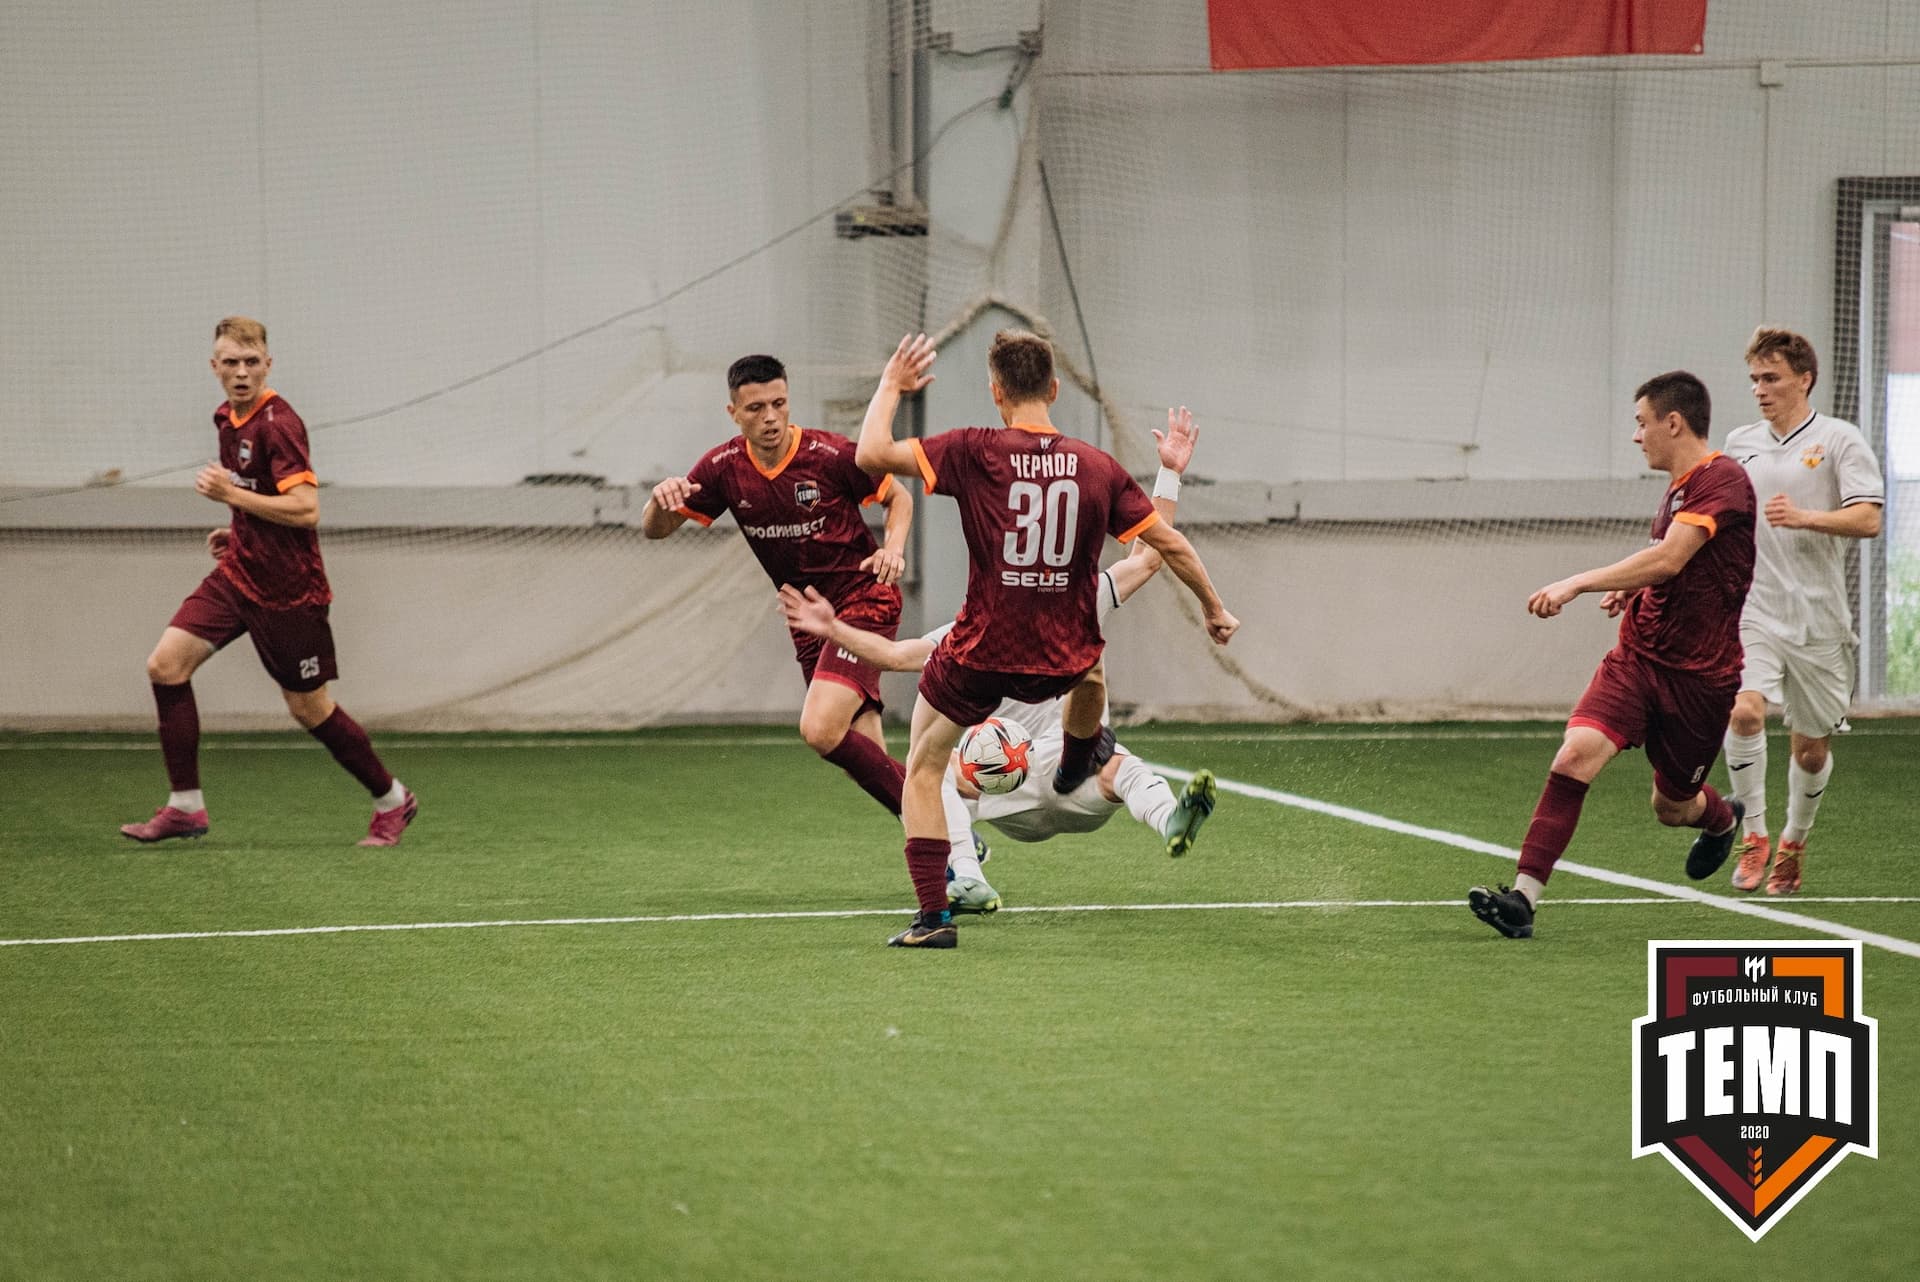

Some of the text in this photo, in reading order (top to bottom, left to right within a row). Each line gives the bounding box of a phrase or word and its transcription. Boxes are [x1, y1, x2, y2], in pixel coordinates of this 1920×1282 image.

[1010, 453, 1078, 479] ЧЕРНОВ
[1003, 479, 1080, 567] 30
[1001, 570, 1070, 588] SEUS
[299, 655, 320, 680] 25
